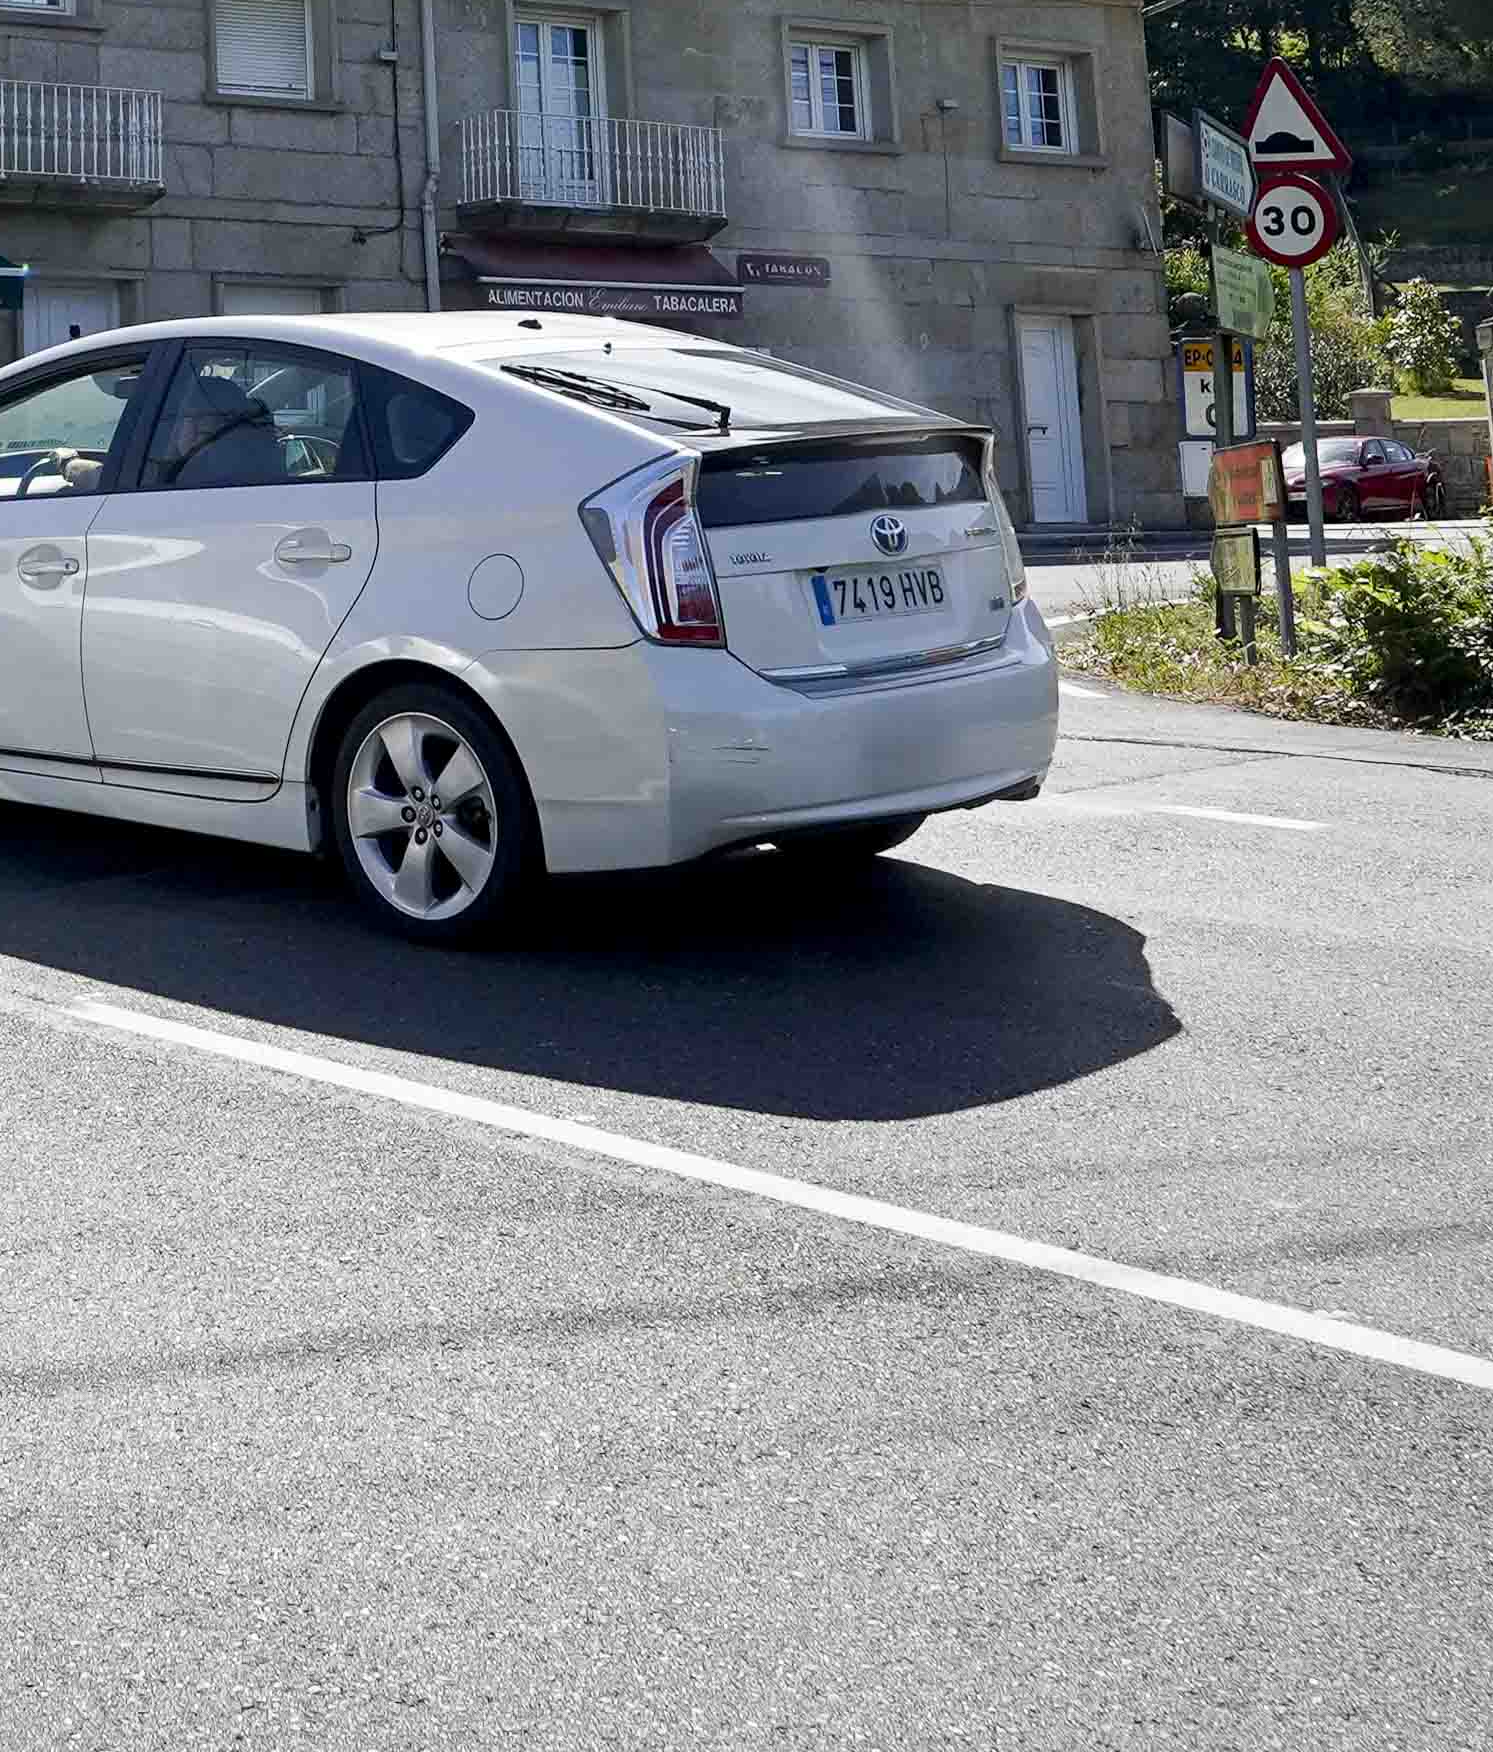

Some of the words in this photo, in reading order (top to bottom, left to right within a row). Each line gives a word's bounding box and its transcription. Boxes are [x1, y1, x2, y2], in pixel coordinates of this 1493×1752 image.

[1262, 205, 1316, 236] 30
[488, 289, 584, 308] ALIMENTACION
[653, 295, 737, 313] TABACALERA
[833, 575, 896, 616] 7419
[899, 570, 944, 608] HVB
